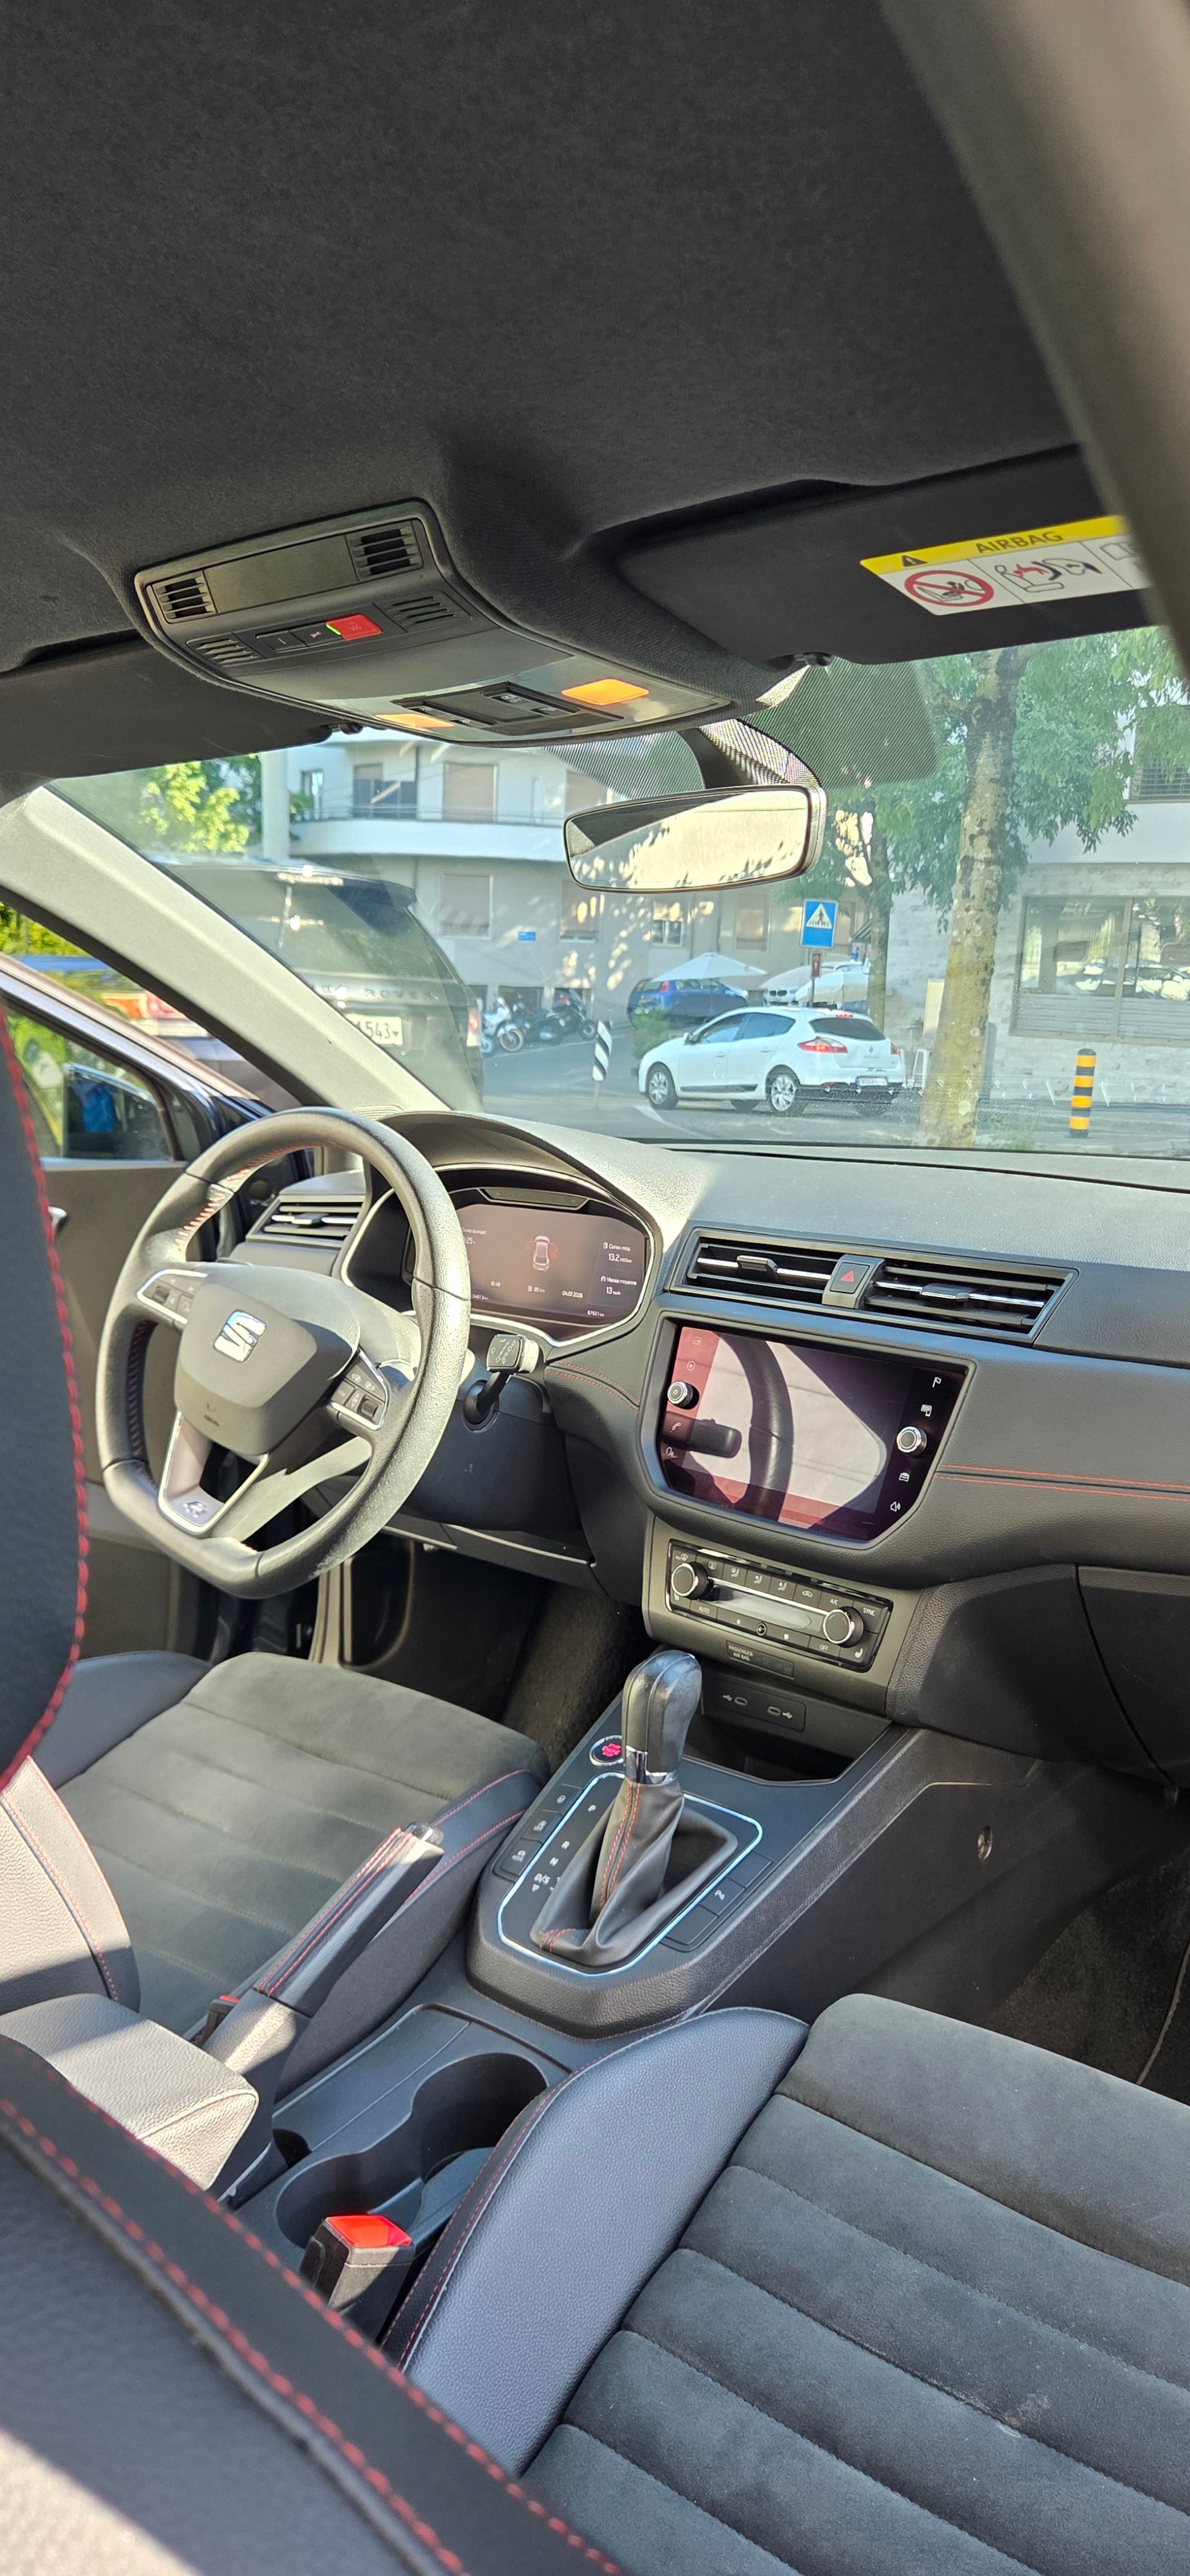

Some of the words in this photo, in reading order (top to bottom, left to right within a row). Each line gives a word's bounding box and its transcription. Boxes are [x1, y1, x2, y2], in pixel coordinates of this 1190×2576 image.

[976, 531, 1064, 553] AIRBAG
[608, 1253, 619, 1262] 13.2
[863, 1607, 876, 1616] SYNC
[728, 1644, 753, 1657] PASSENGER
[561, 1841, 570, 1850] R
[549, 1857, 558, 1866] N
[534, 1873, 551, 1886] D/S
